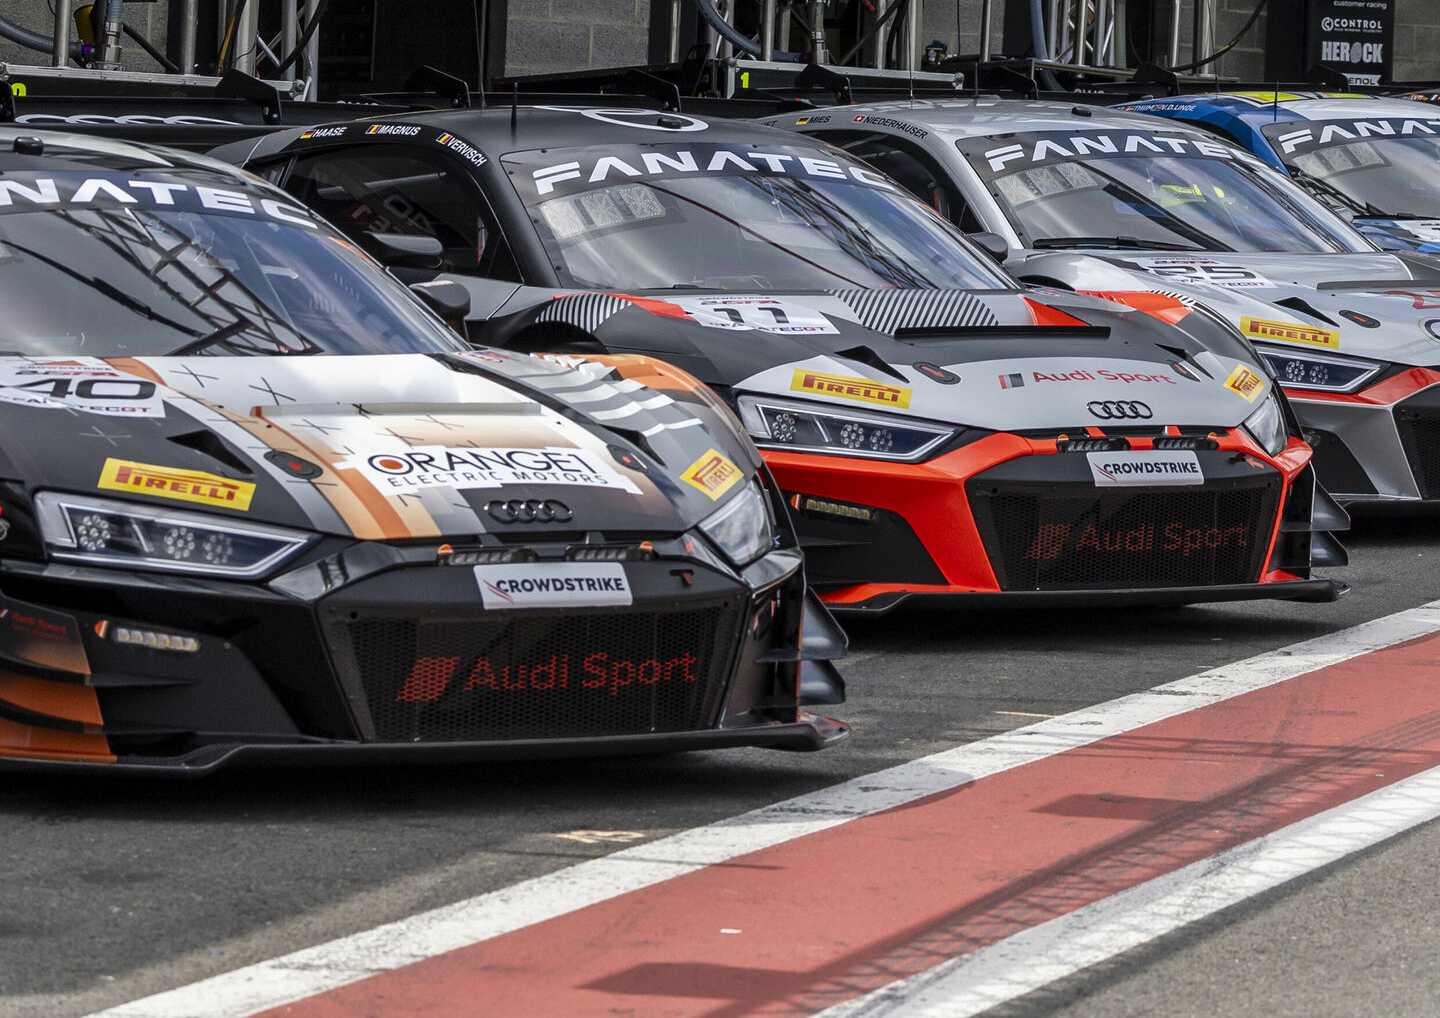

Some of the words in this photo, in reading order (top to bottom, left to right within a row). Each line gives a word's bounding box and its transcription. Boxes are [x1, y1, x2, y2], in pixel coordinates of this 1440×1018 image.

[1334, 0, 1365, 8] customer
[1366, 1, 1387, 10] racing
[1334, 18, 1383, 30] CONTROL
[1322, 41, 1384, 63] HEROCK
[1348, 77, 1376, 86] ENOL
[377, 125, 421, 135] MAGNUS
[808, 115, 831, 124] MIES
[863, 116, 929, 139] NIEDERHAUSER
[312, 126, 347, 138] HAASE
[447, 137, 487, 168] VERVISCH
[533, 151, 893, 195] FANATEC
[0, 178, 318, 230] NATEC
[713, 307, 789, 324] 11
[1249, 320, 1331, 344] PIRELLI
[802, 373, 901, 402] PIRELLI
[1033, 370, 1094, 383] Audi
[1096, 369, 1177, 385] Sport
[1231, 370, 1260, 397] PIRELLI
[0, 378, 156, 399] 40
[367, 450, 598, 476] ORANGE1
[1103, 461, 1199, 474] CROWDSTRIKE
[115, 465, 240, 501] PIRELLI
[387, 471, 503, 487] ELECTRIC
[514, 471, 609, 484] MOTORS
[691, 456, 736, 493] PIRELLI
[1076, 523, 1154, 551] Audi
[1163, 521, 1248, 557] Sport
[495, 577, 625, 594] CROWDSTRIKE
[463, 654, 569, 691] Audi
[582, 651, 697, 696] Sport
